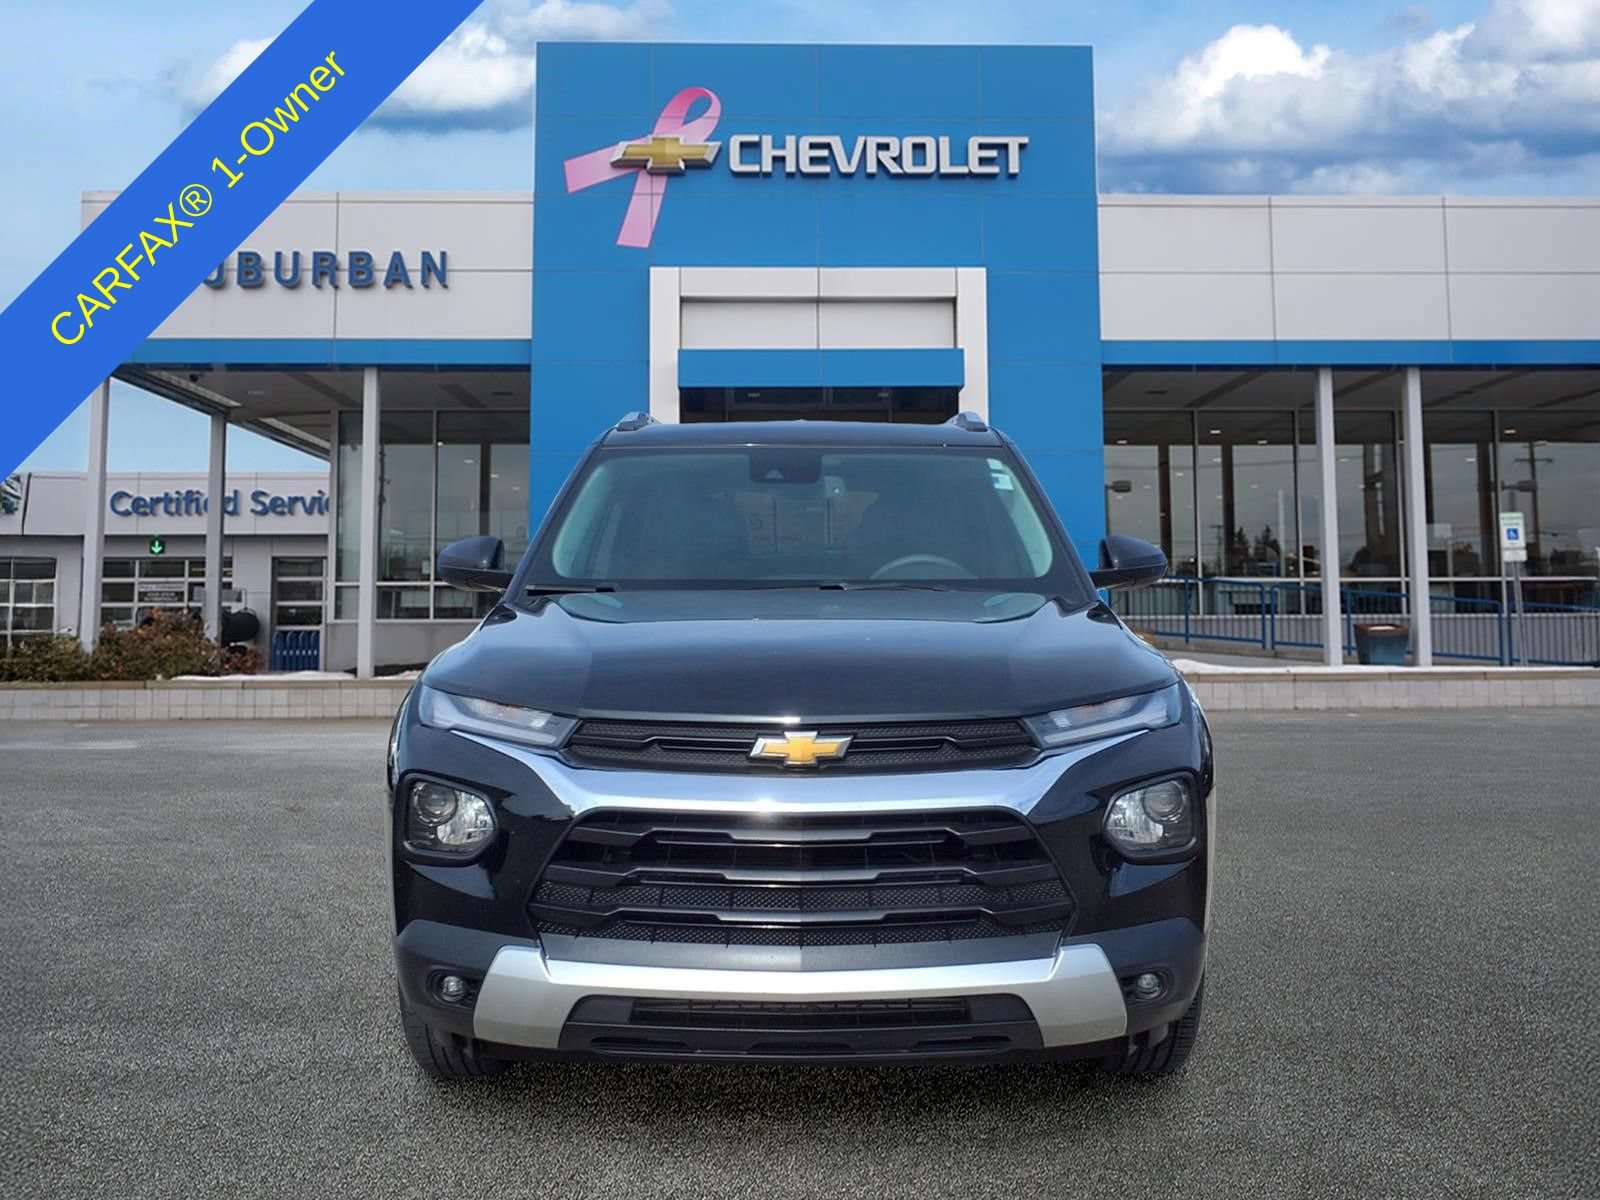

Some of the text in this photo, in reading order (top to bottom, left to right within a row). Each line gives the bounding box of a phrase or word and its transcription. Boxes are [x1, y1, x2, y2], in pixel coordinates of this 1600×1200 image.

[728, 134, 1029, 177] CHEVROLET
[203, 250, 448, 289] UBURBAN
[249, 489, 330, 516] Servi
